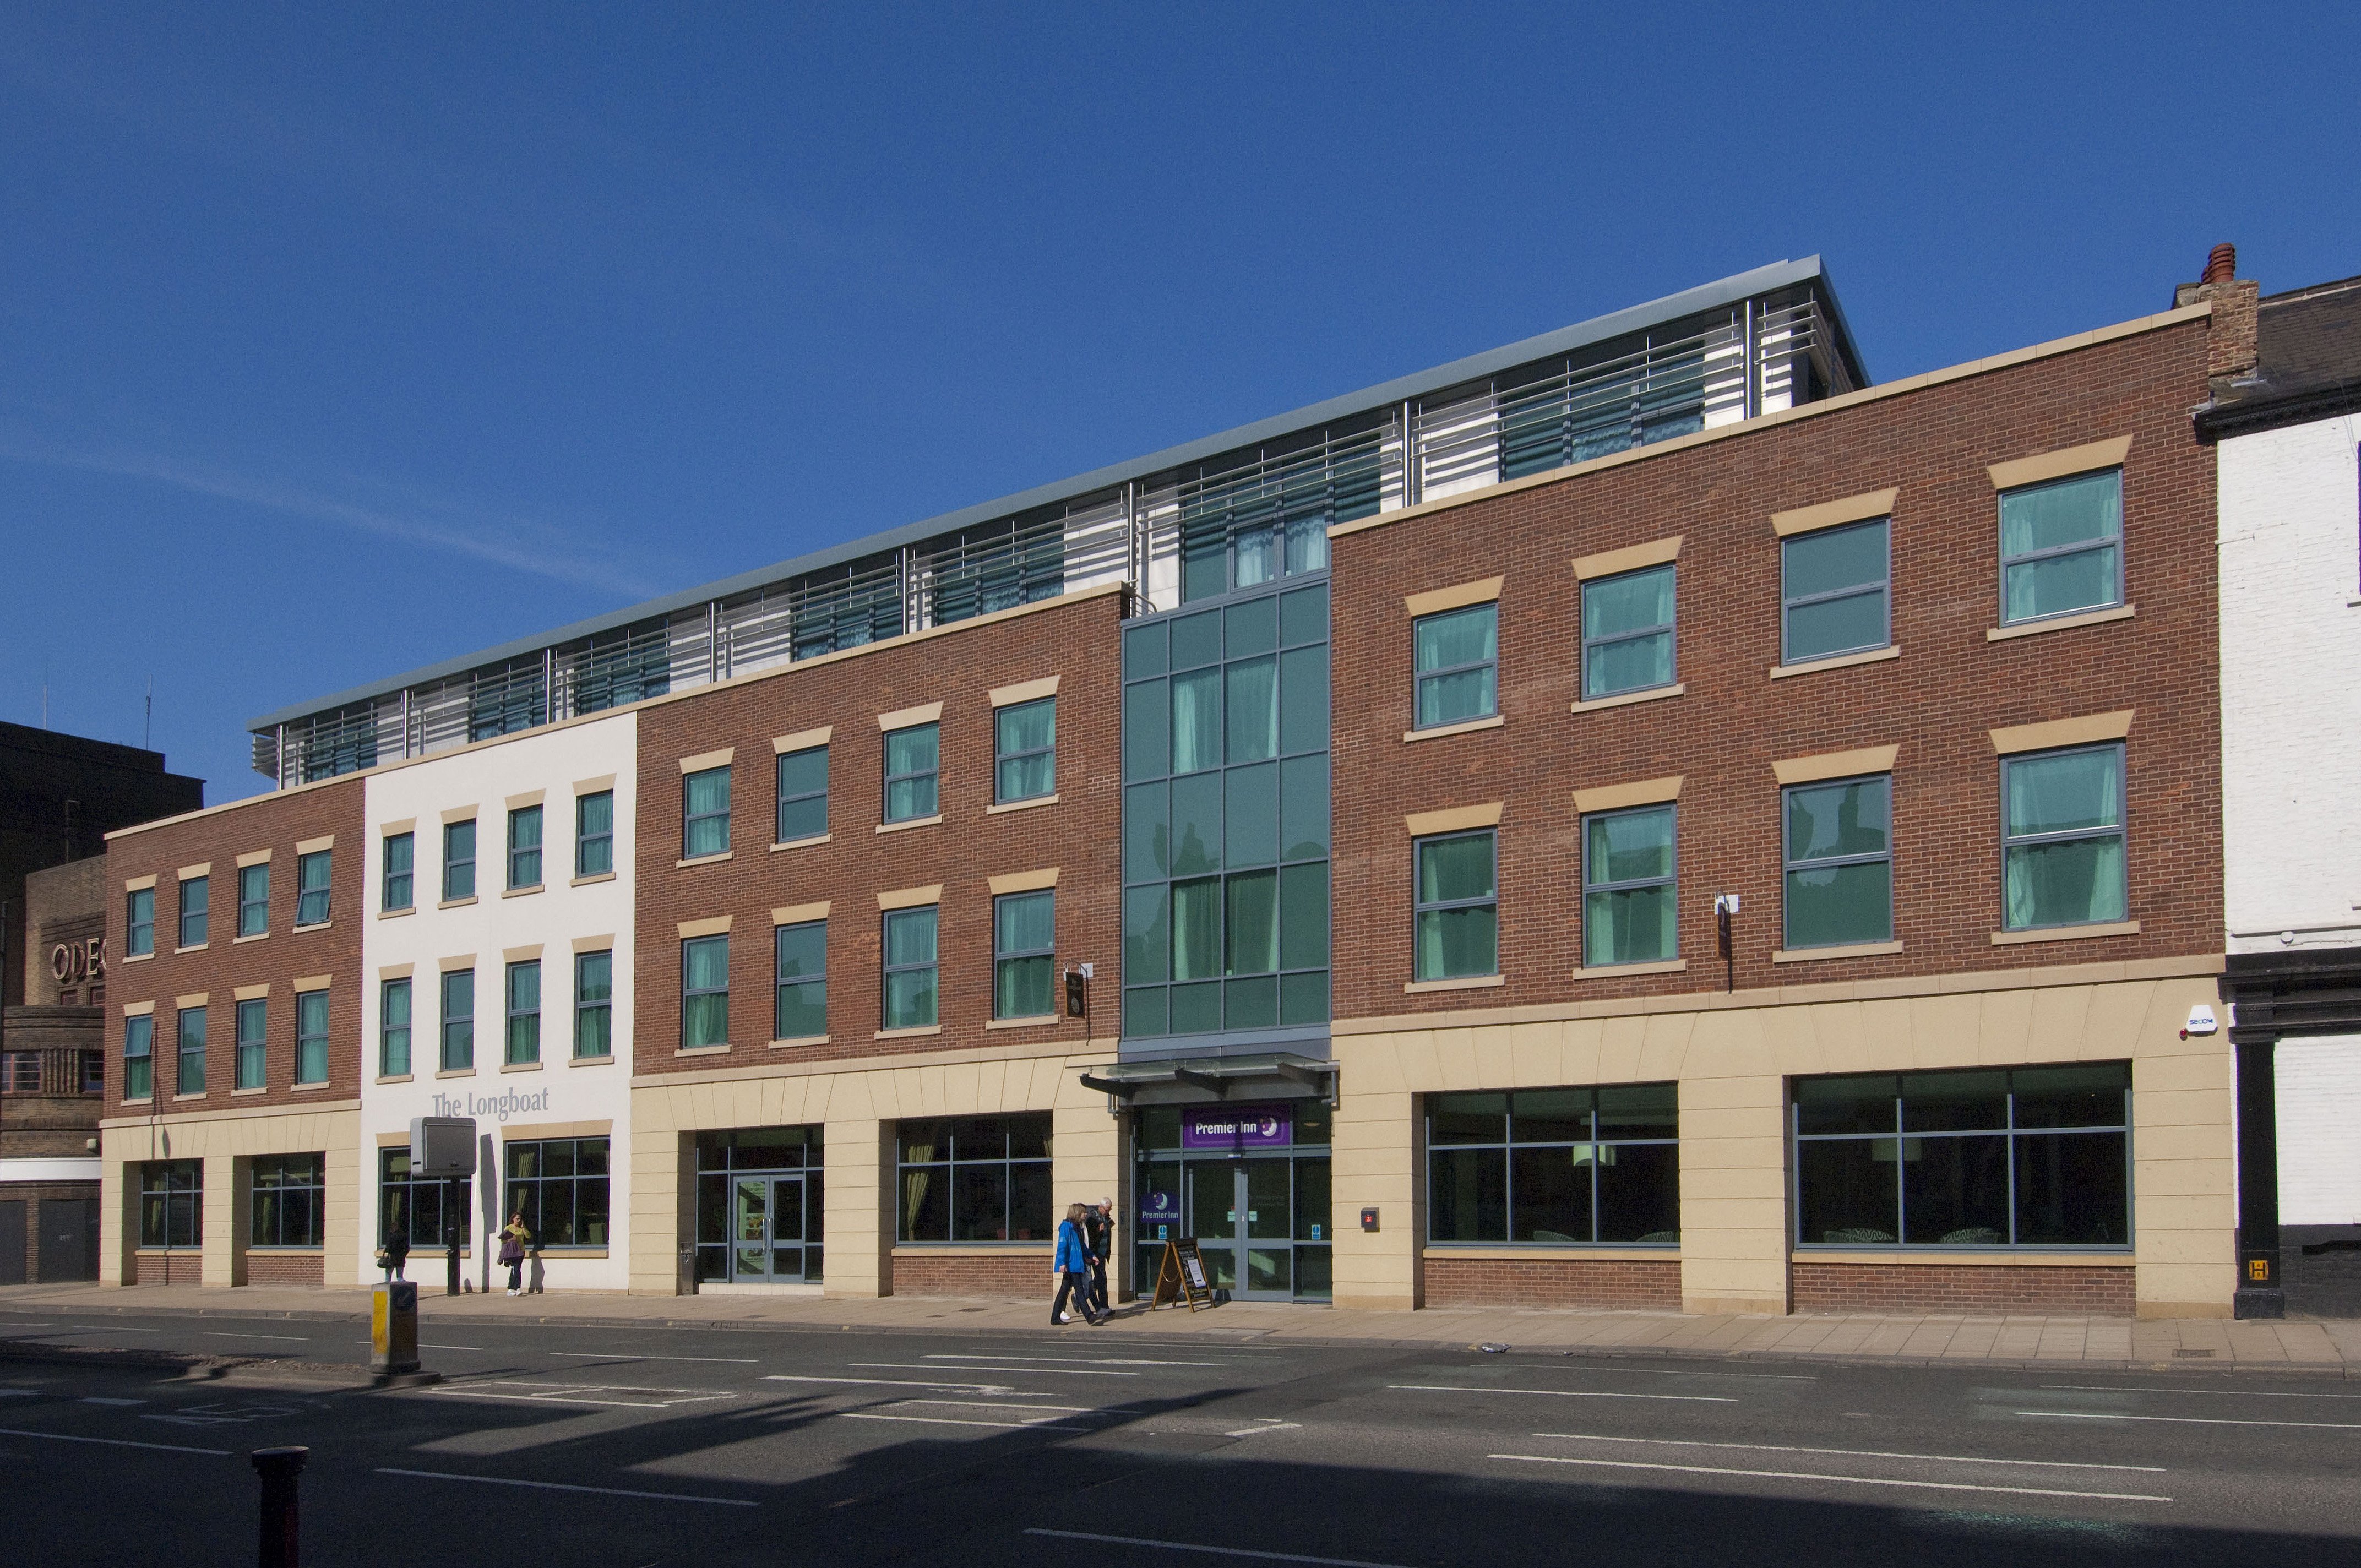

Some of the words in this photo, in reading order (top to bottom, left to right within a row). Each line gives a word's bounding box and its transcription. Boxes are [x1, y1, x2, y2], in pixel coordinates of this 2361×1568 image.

[432, 1092, 461, 1117] The
[468, 1087, 548, 1122] Longboat
[1196, 1121, 1238, 1135] Premier
[1241, 1121, 1257, 1133] Inn
[1142, 1211, 1167, 1219] Premier
[1168, 1211, 1178, 1219] Inn
[2252, 1262, 2266, 1278] H
